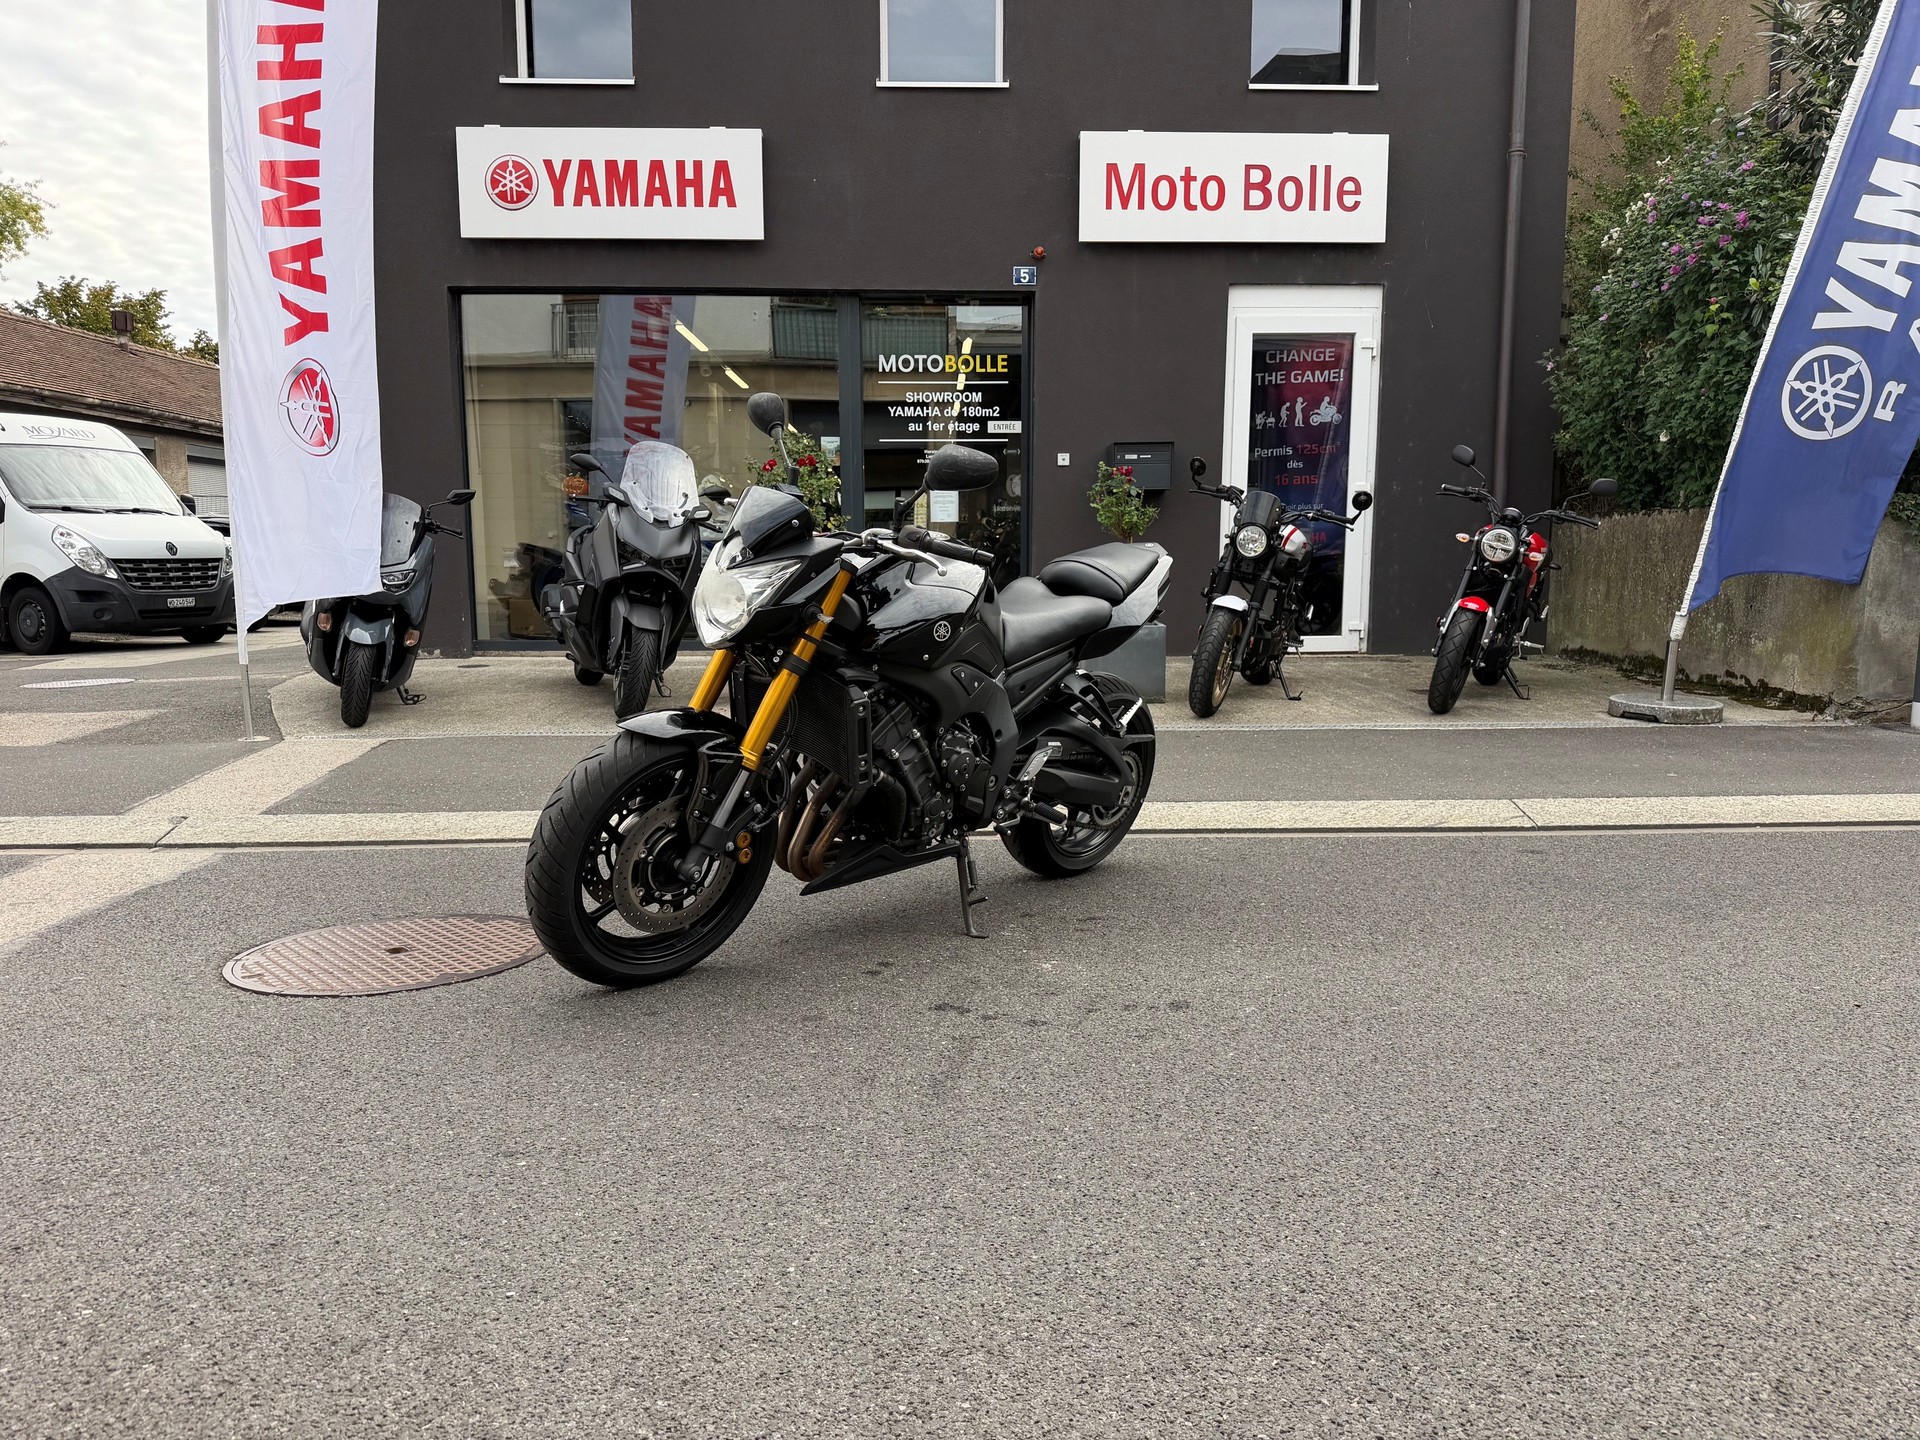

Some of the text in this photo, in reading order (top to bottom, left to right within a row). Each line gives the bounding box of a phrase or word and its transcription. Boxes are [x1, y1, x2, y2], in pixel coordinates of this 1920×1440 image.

[257, 0, 329, 347] YAMAH
[542, 158, 738, 208] YAMAHA
[1105, 162, 1363, 213] Moto Bolle
[1020, 268, 1030, 283] 5
[1265, 347, 1336, 364] CHANGE
[878, 354, 1009, 373] MOTOBOLLE
[1254, 368, 1344, 386] THE GAME!
[905, 391, 982, 403] SHOWROOM
[888, 406, 1000, 417] YAMAHA de 180m2
[908, 420, 980, 434] au 1er étage
[993, 422, 1016, 431] ENTRÉE
[1254, 445, 1293, 458] Permis
[1286, 460, 1304, 469] dès
[1274, 474, 1320, 486] 16 ans
[1297, 503, 1312, 511] plus
